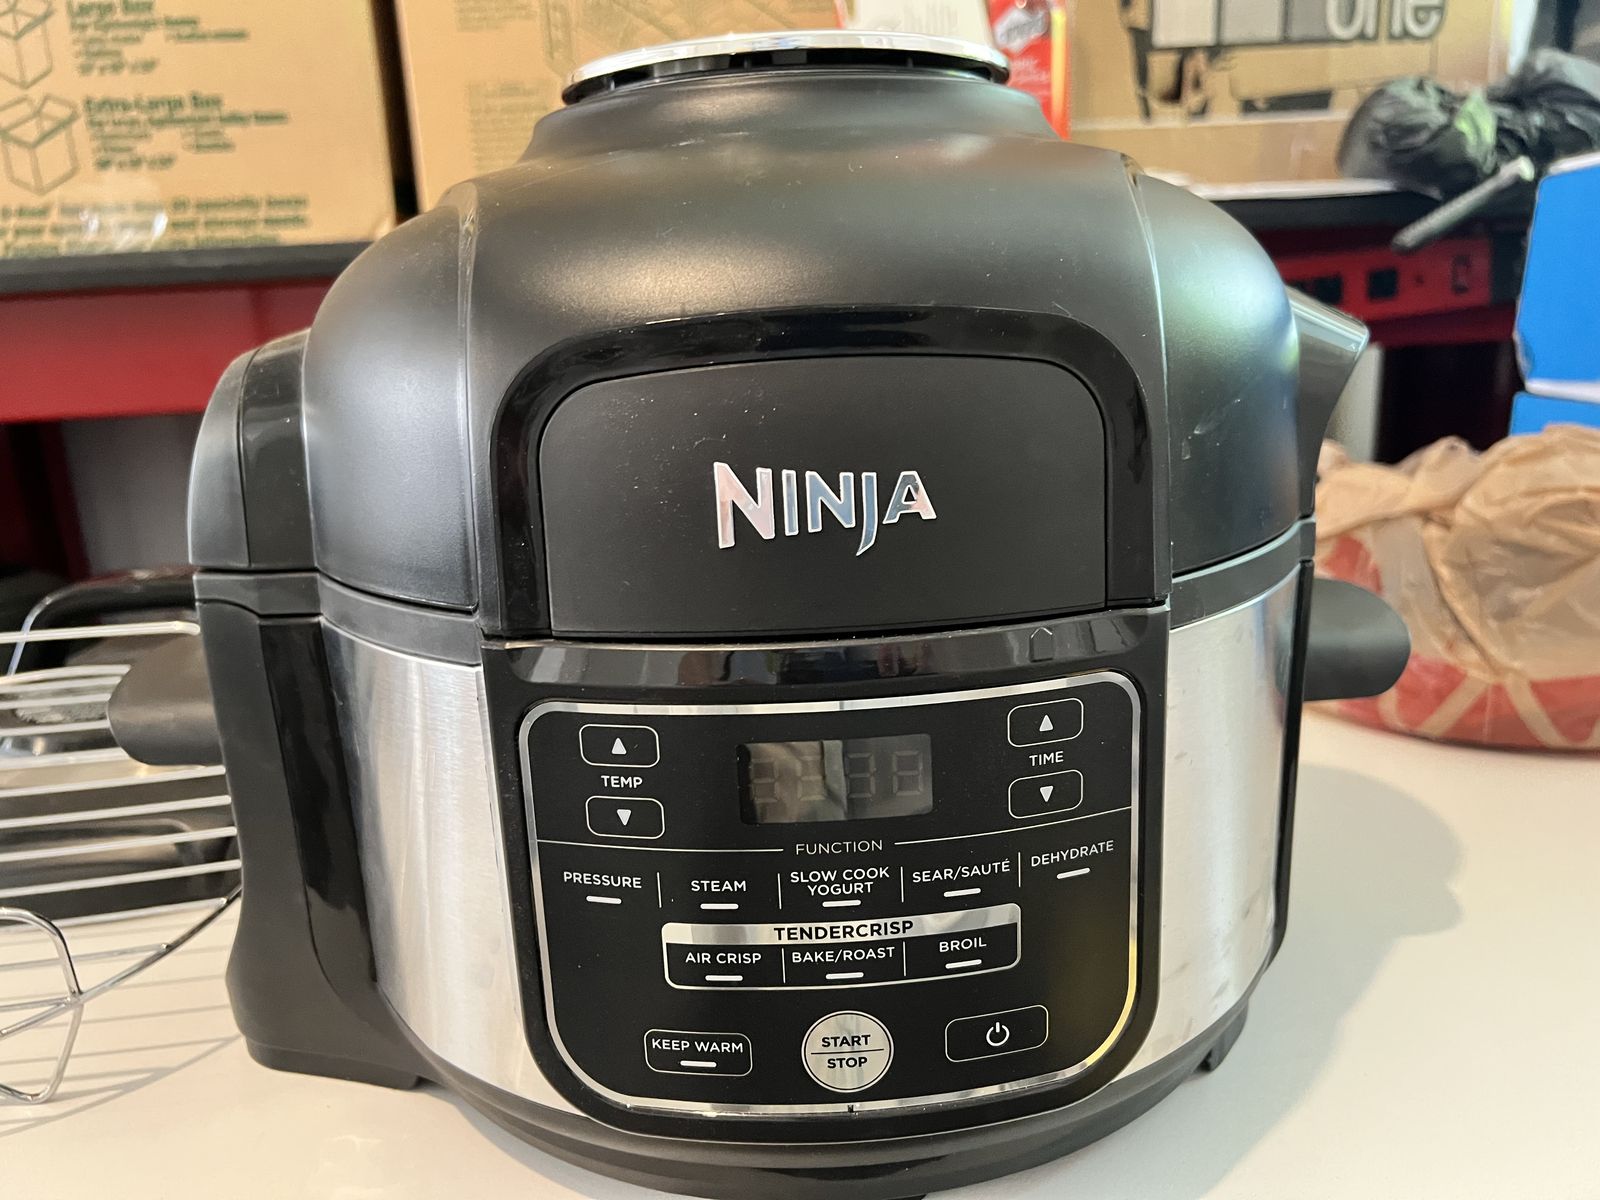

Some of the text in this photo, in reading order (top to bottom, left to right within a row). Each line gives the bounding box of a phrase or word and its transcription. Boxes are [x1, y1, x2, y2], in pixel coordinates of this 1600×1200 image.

[713, 461, 937, 557] NINJA
[1028, 750, 1064, 767] TIME
[600, 775, 643, 789] TEMP
[795, 839, 883, 856] FUNCTION
[1031, 839, 1115, 868] DEHYDRATE
[790, 866, 890, 883] SLOW COOK
[912, 858, 1011, 883] SEAR/SAUTÉ
[563, 871, 642, 889] PRESSURE
[690, 880, 747, 892] STEAM
[807, 881, 874, 897] YOGURT
[773, 919, 914, 941] TENDERCRISP
[938, 936, 987, 953] BROIL
[685, 951, 762, 965] AIR CRISP
[791, 946, 896, 964] BAKE/ROAST
[651, 1038, 744, 1054] KEEP WARM
[821, 1034, 871, 1048] START
[827, 1056, 868, 1069] STOP
